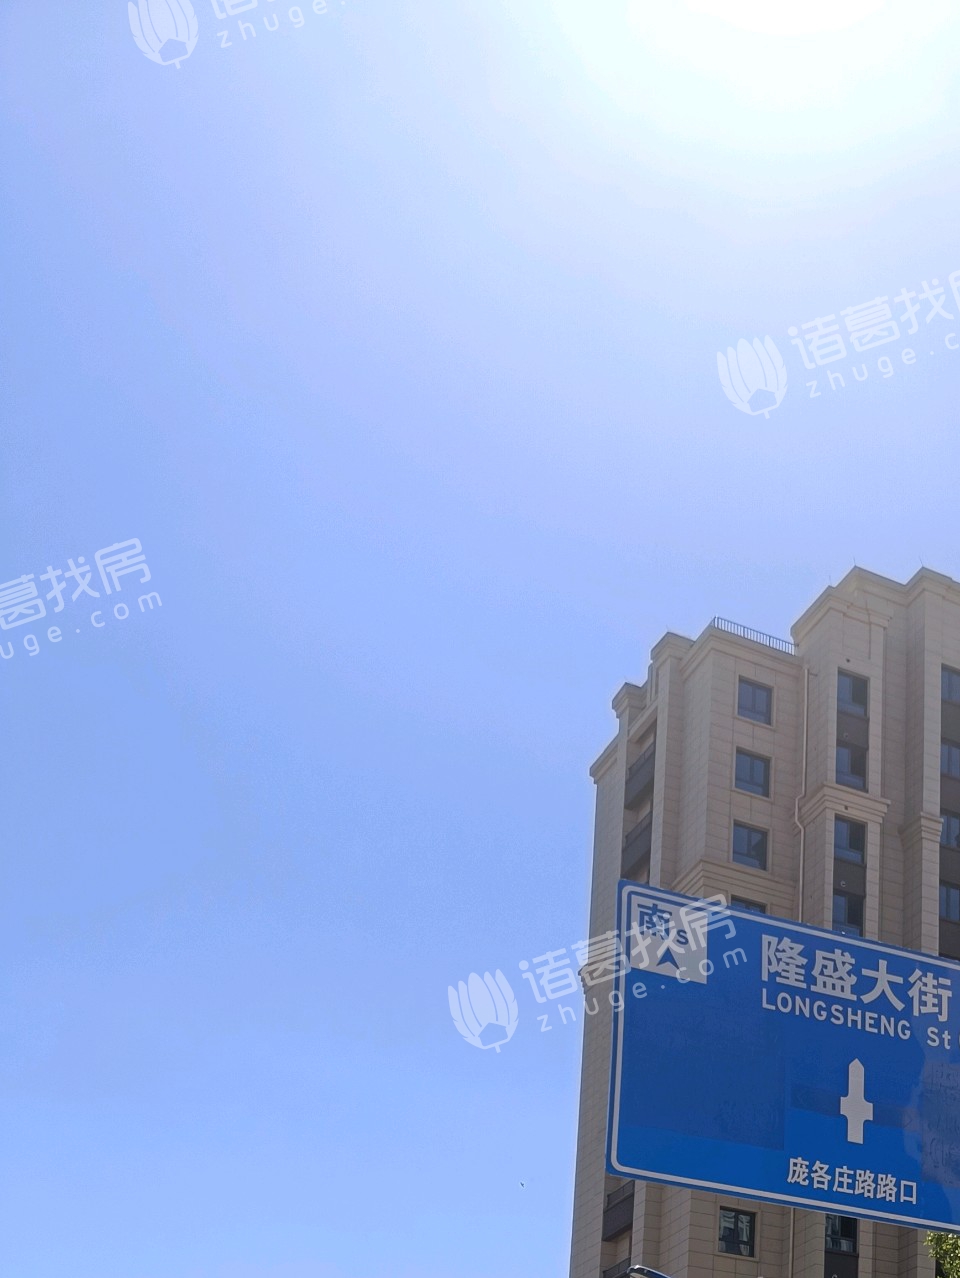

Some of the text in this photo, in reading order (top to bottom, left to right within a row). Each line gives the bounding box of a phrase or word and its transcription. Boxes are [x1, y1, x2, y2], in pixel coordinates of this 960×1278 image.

[637, 903, 672, 940] 南
[762, 934, 953, 1022] 隆盛大街
[762, 988, 911, 1040] LONGSHENG
[927, 1027, 951, 1050] St
[787, 1157, 917, 1205] 庞各庄路路口
